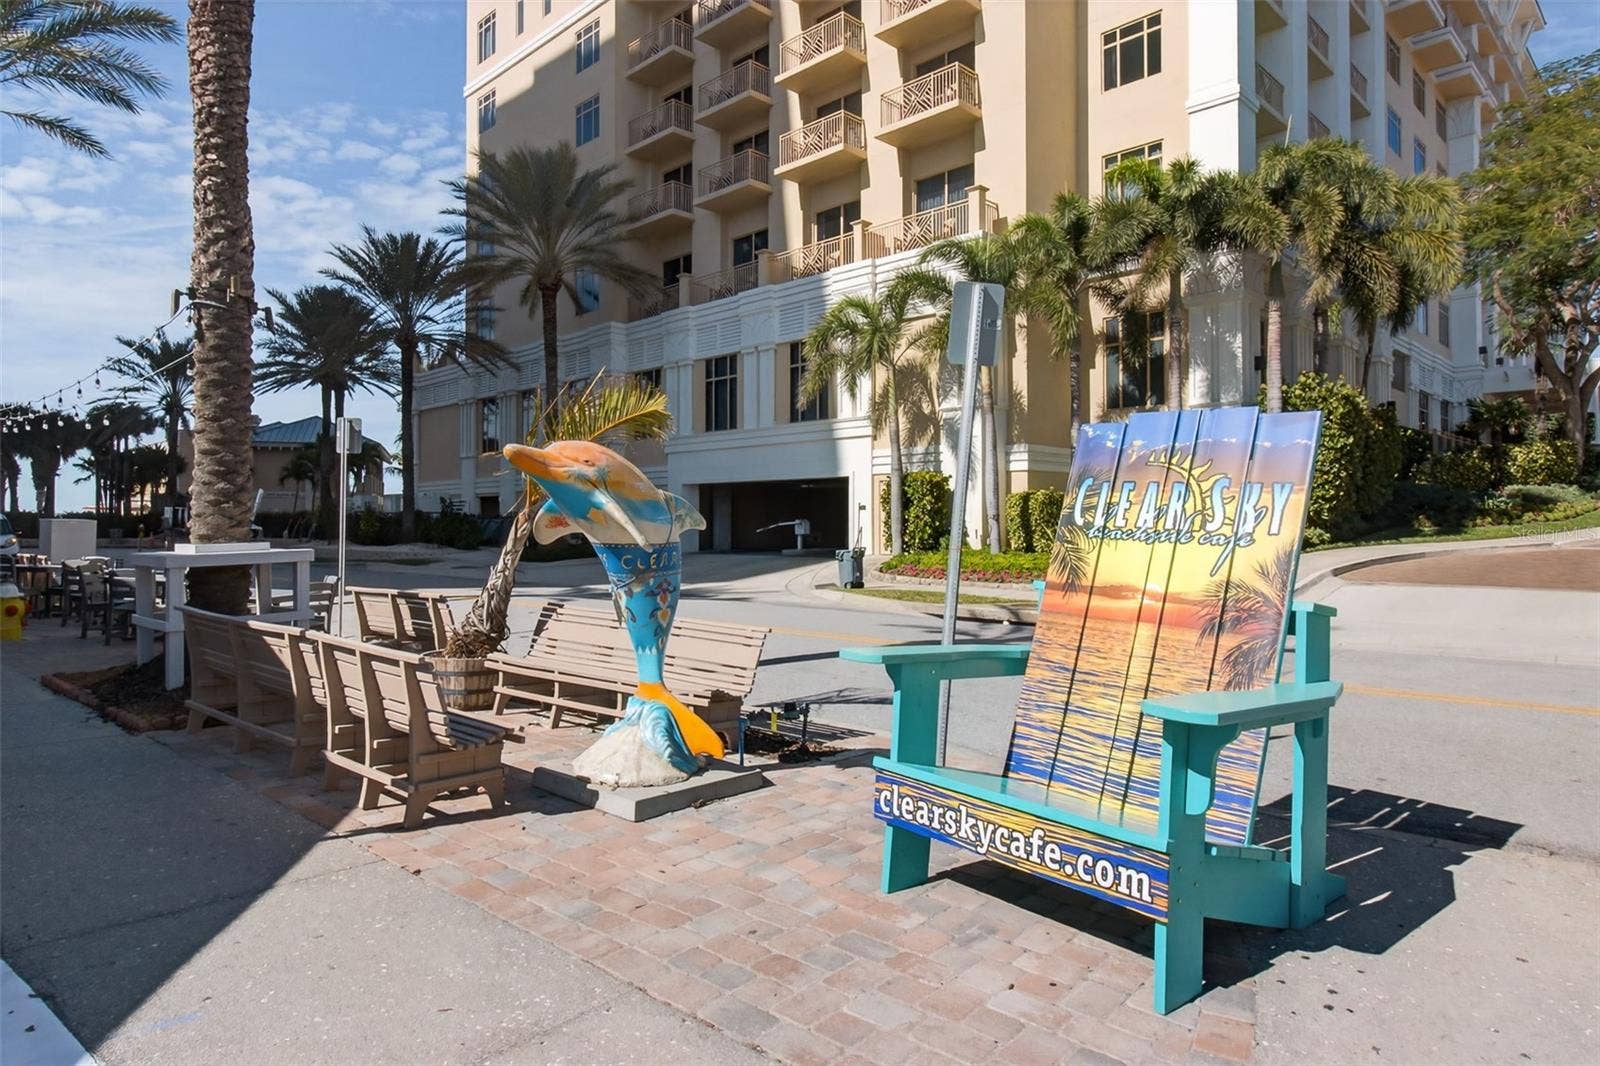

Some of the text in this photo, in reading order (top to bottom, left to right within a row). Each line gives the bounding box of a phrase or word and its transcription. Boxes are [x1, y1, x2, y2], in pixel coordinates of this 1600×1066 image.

[1073, 474, 1294, 535] CLEAR SKY
[879, 783, 1153, 903] clearskycafe.com
